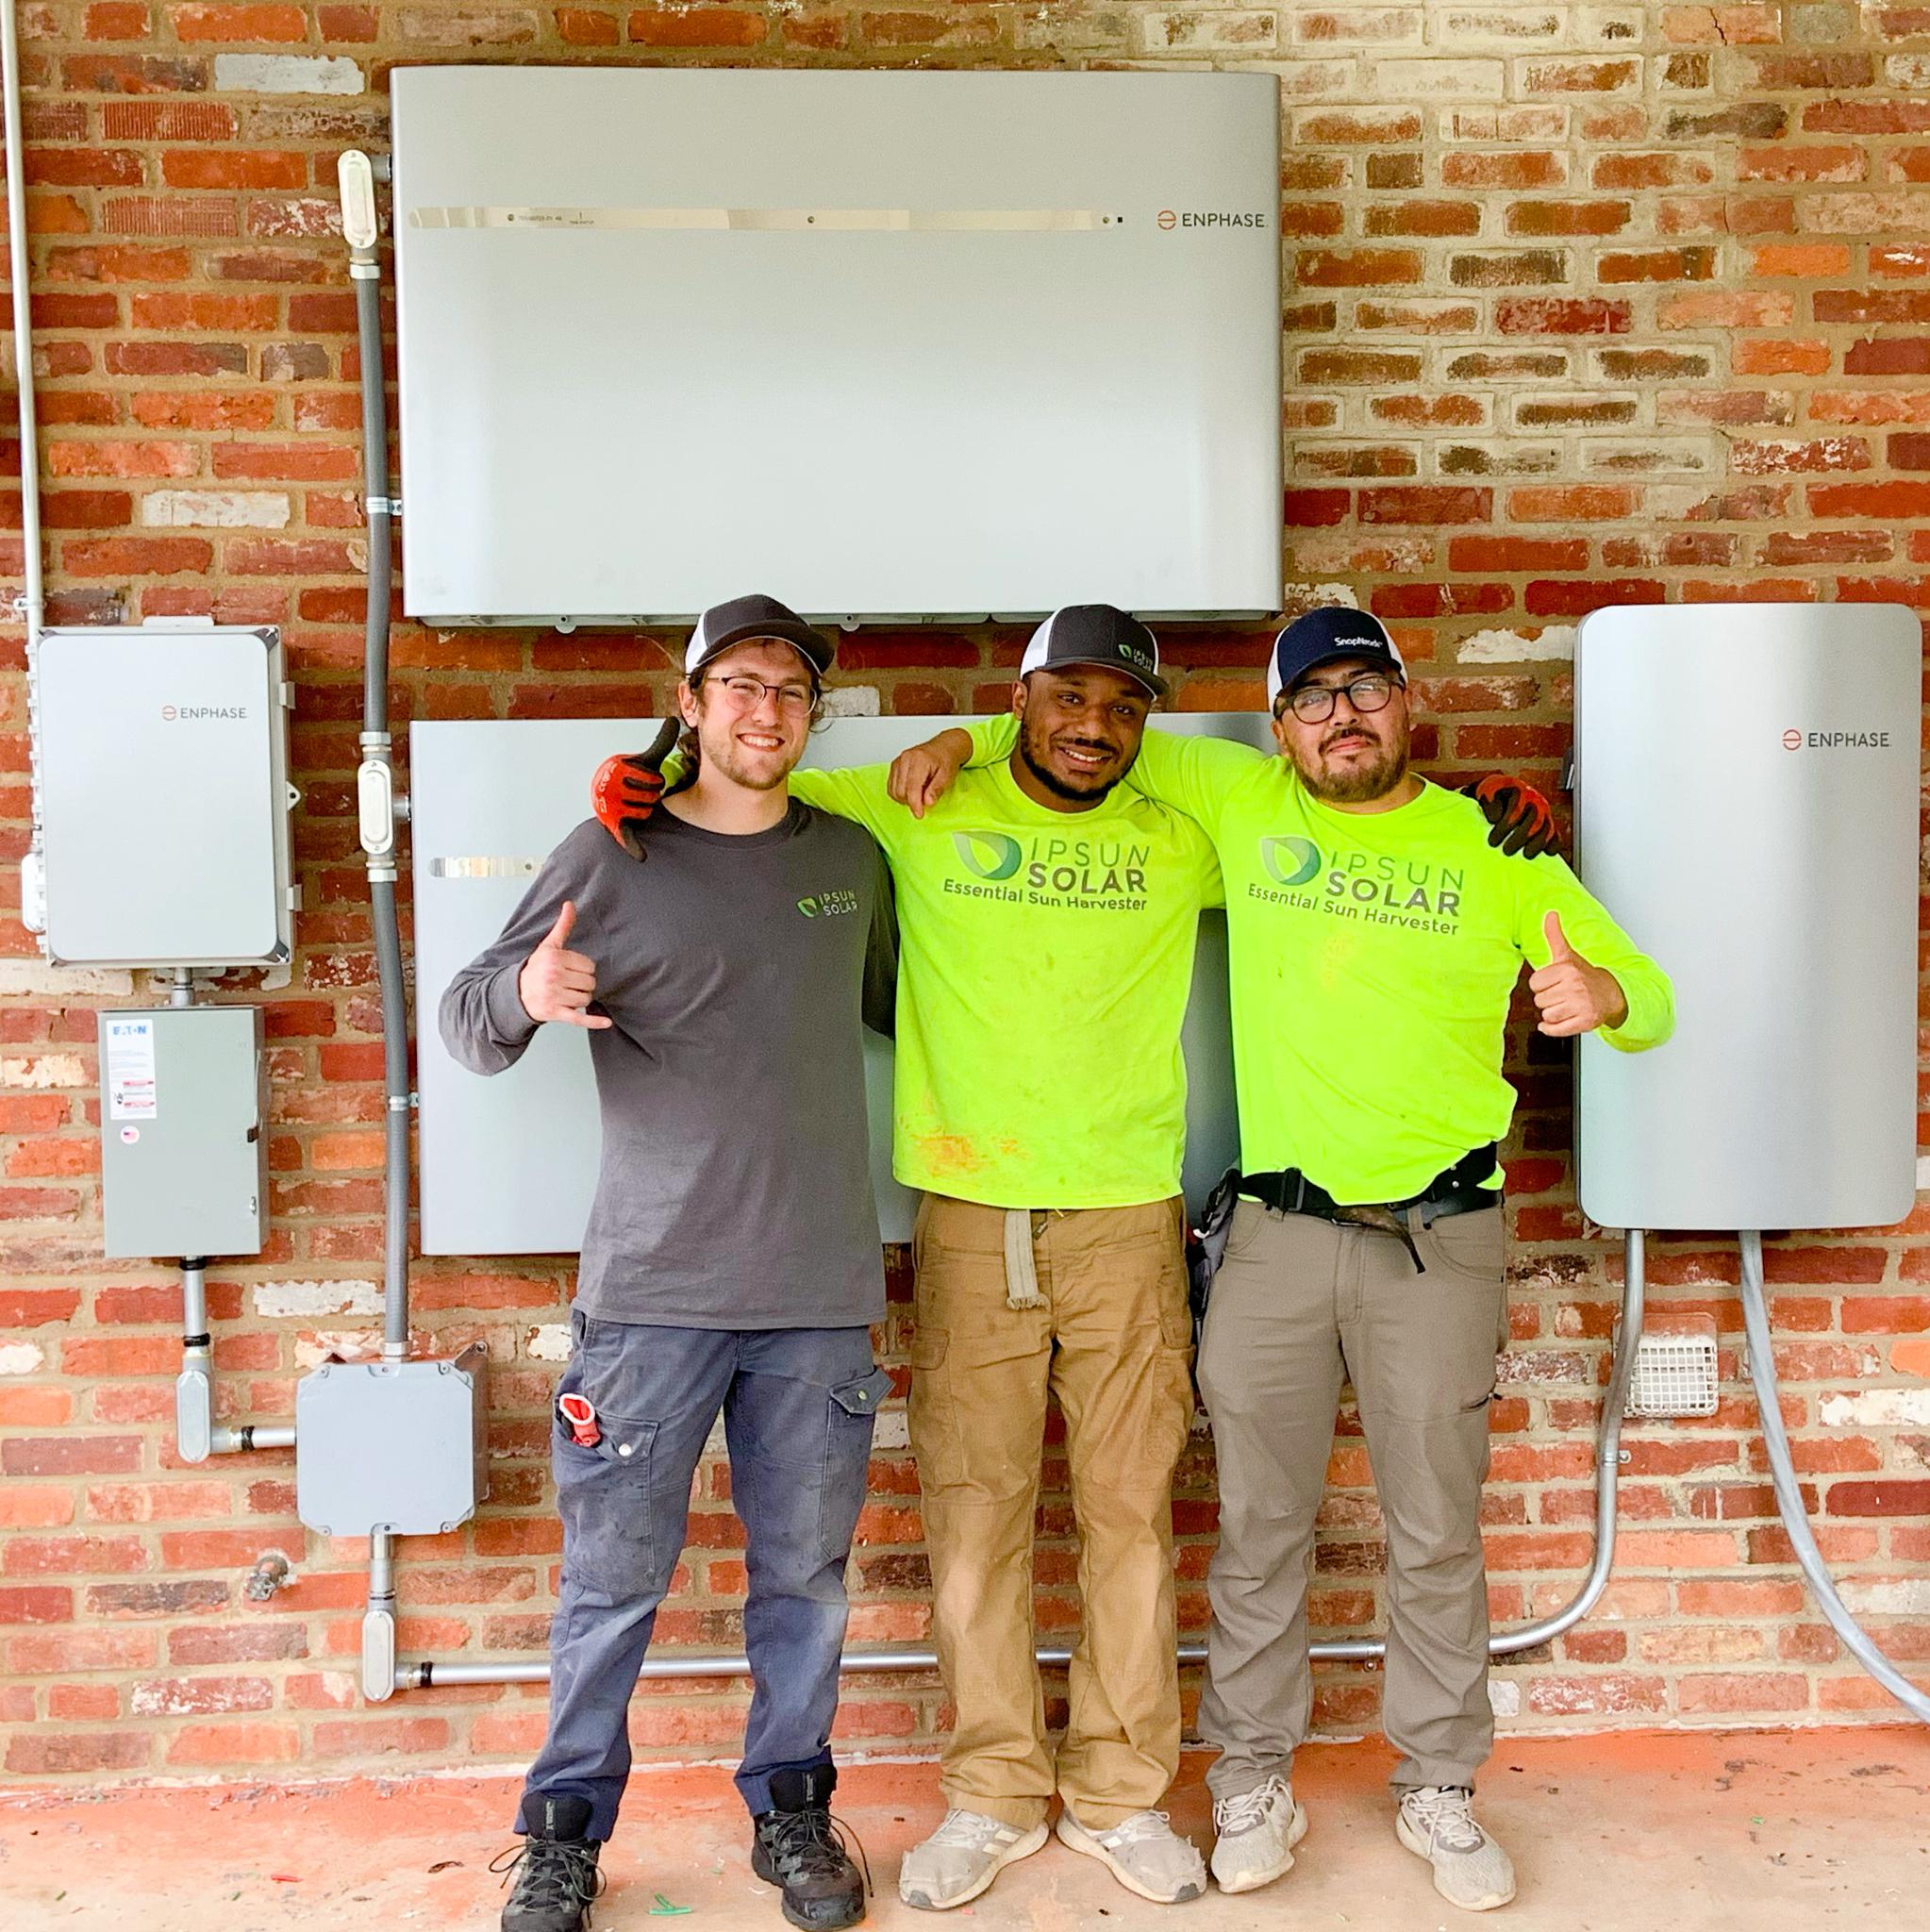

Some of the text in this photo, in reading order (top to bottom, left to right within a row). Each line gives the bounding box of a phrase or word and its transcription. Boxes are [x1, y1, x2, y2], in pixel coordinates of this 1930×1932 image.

[1181, 212, 1266, 228] ENPHASE
[179, 707, 247, 719] ENPHASE
[1807, 732, 1890, 748] ENPHASE
[1030, 837, 1151, 868] IPSUN
[1027, 862, 1148, 894] SOLAR
[1330, 850, 1464, 891] IPSUN
[818, 890, 856, 906] IPSUN
[823, 901, 857, 917] SOLAR
[942, 878, 1148, 910] Essential Sun Harvester
[1247, 882, 1459, 936] Essential Sun Harvester
[1324, 871, 1460, 917] SOLAR
